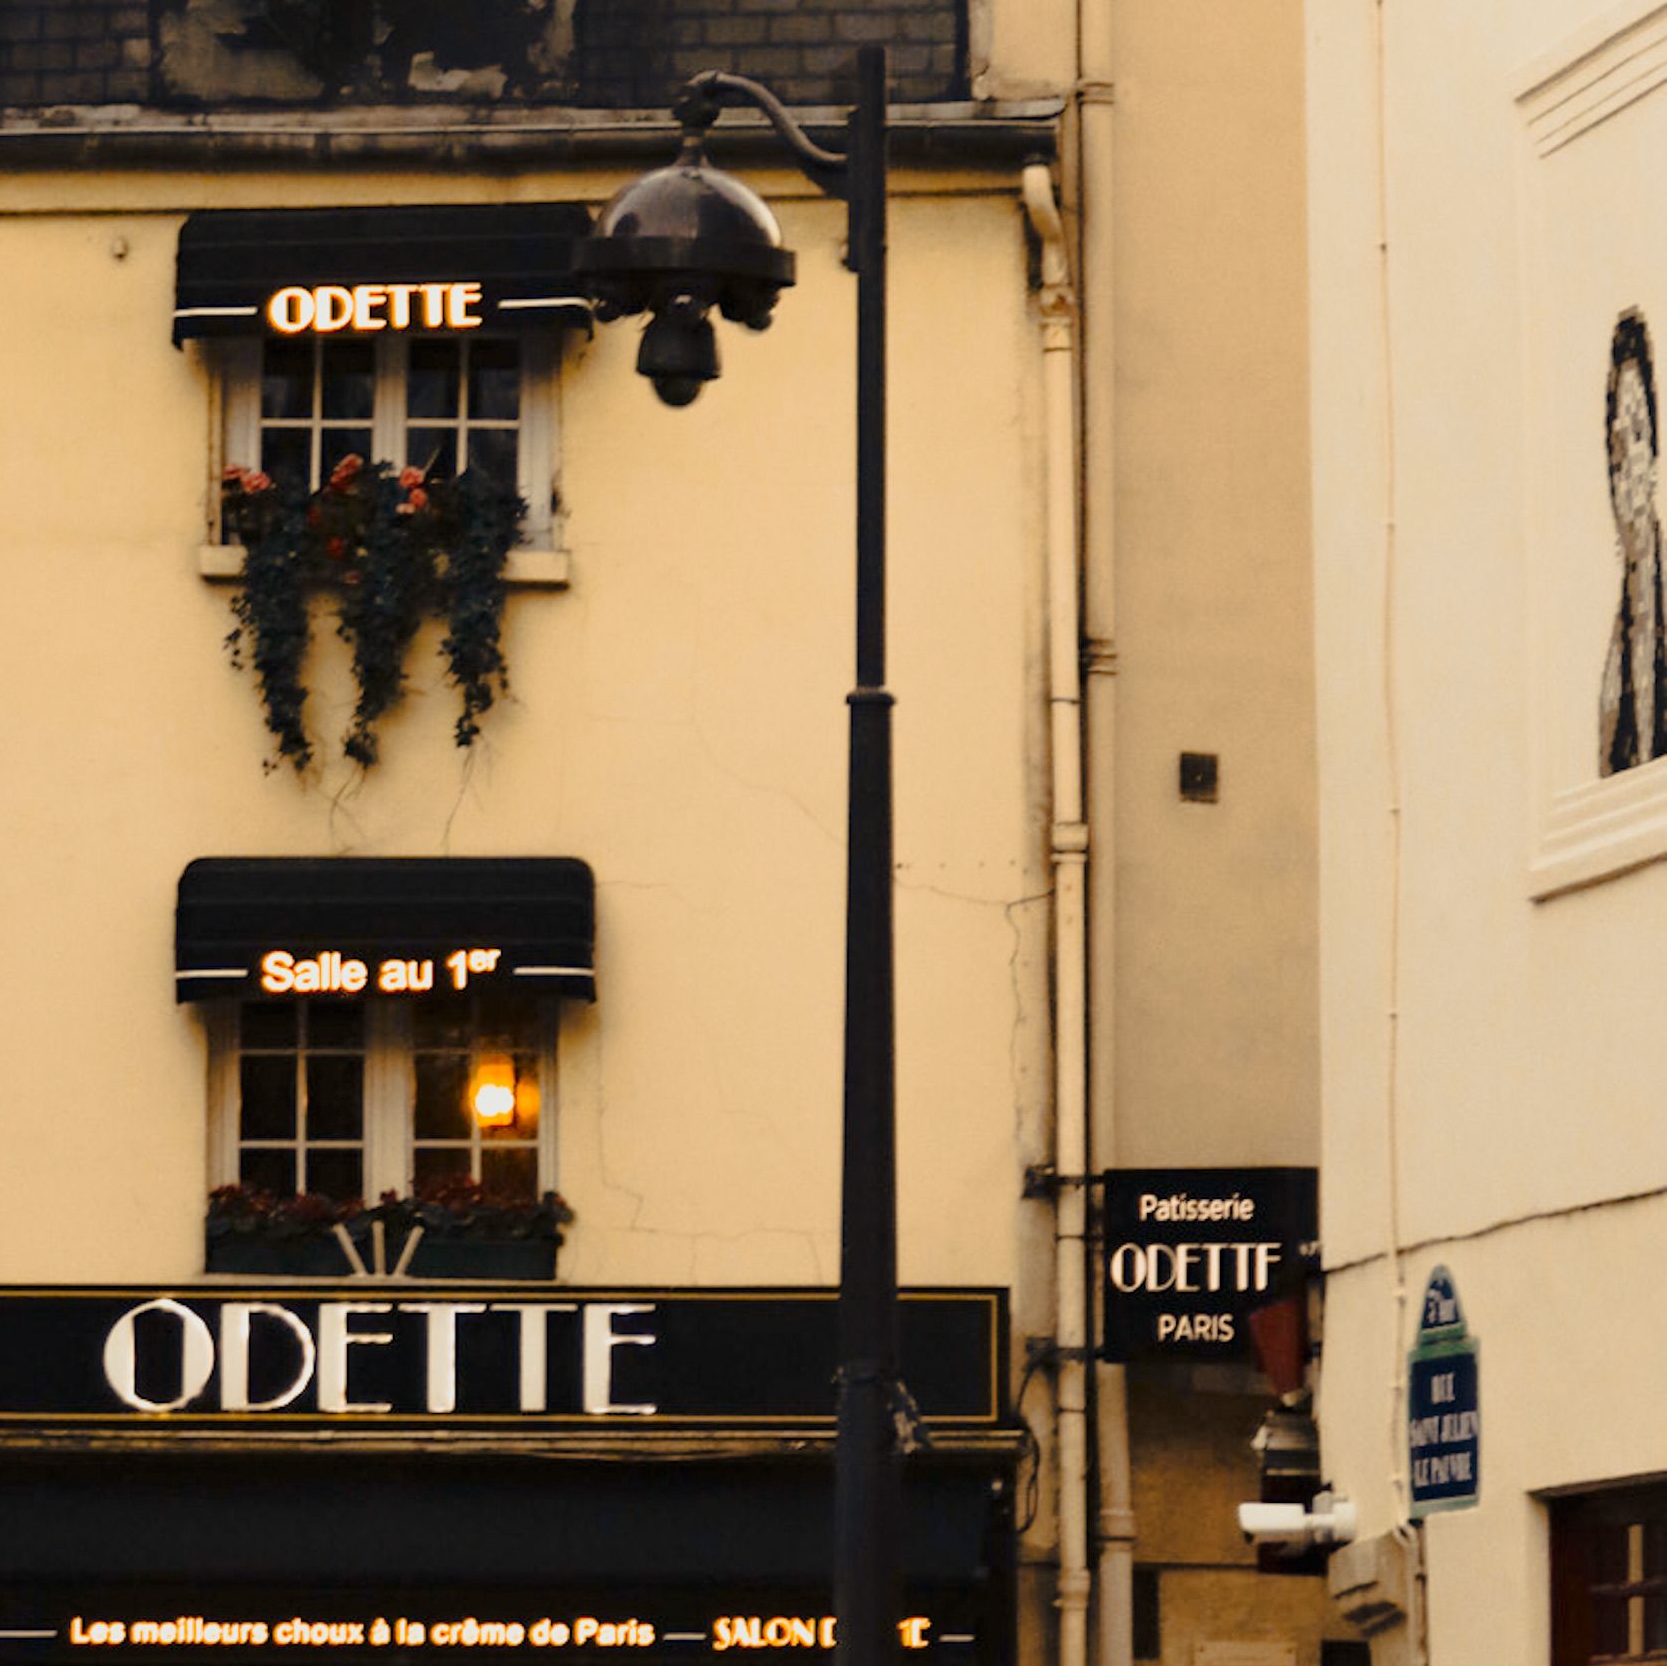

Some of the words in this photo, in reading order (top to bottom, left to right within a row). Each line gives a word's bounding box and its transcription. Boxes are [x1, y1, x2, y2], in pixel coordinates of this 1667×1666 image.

[267, 282, 482, 334] ODETTE
[260, 950, 369, 993] Salle
[377, 959, 434, 993] au
[445, 948, 502, 990] 1er
[1139, 1192, 1255, 1222] Patisserie
[1157, 1313, 1235, 1342] PARIS
[103, 1297, 657, 1415] ODETTE
[70, 1616, 126, 1645] Les
[130, 1616, 269, 1645] meilleurs
[274, 1617, 364, 1646] choux
[395, 1617, 425, 1646] la
[529, 1618, 570, 1647] de
[574, 1617, 656, 1647] Paris
[713, 1616, 815, 1651] SALON
